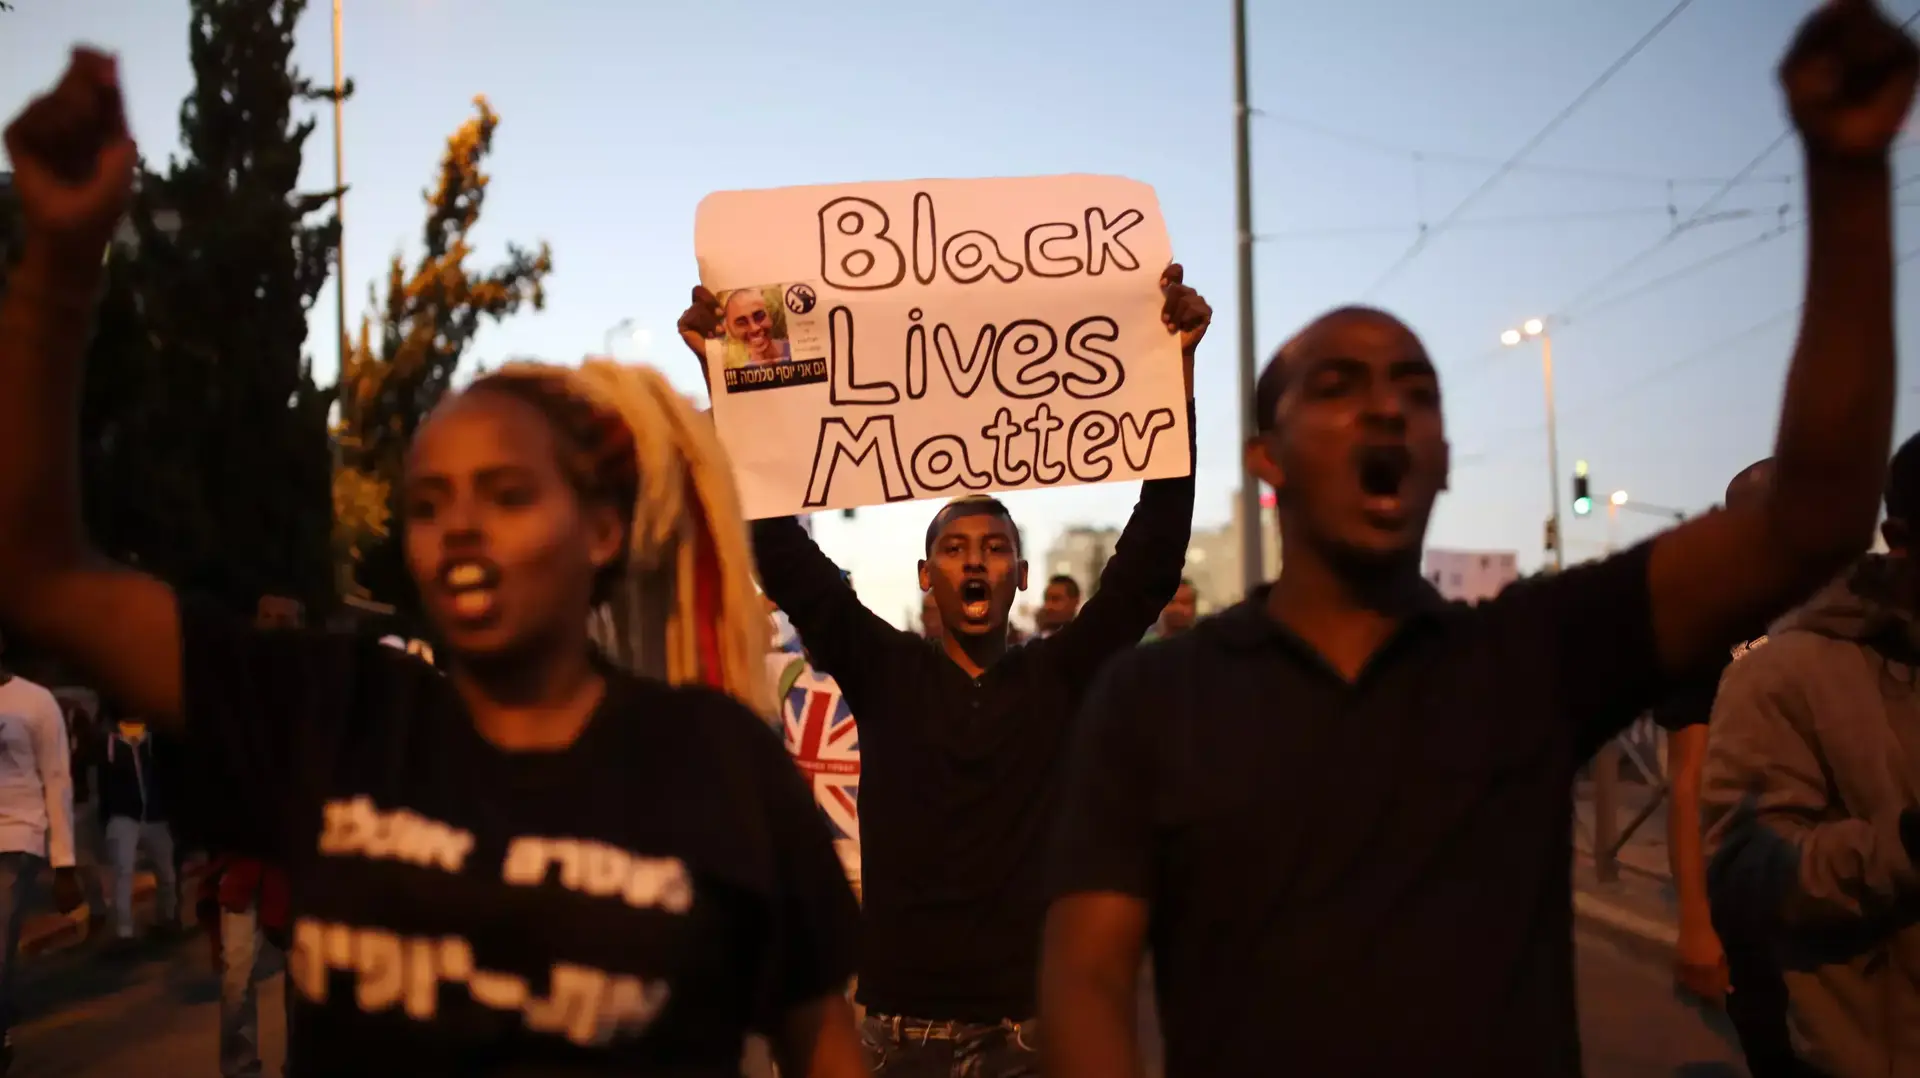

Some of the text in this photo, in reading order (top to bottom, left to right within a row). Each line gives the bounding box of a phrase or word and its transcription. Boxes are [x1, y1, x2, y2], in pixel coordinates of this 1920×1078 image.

[818, 192, 1144, 291] Black
[828, 305, 1125, 406] Lives
[740, 365, 775, 384] סלמסה
[776, 366, 795, 383] יוסף
[797, 363, 813, 378] אני
[813, 362, 826, 375] גם
[802, 403, 1176, 508] Matter
